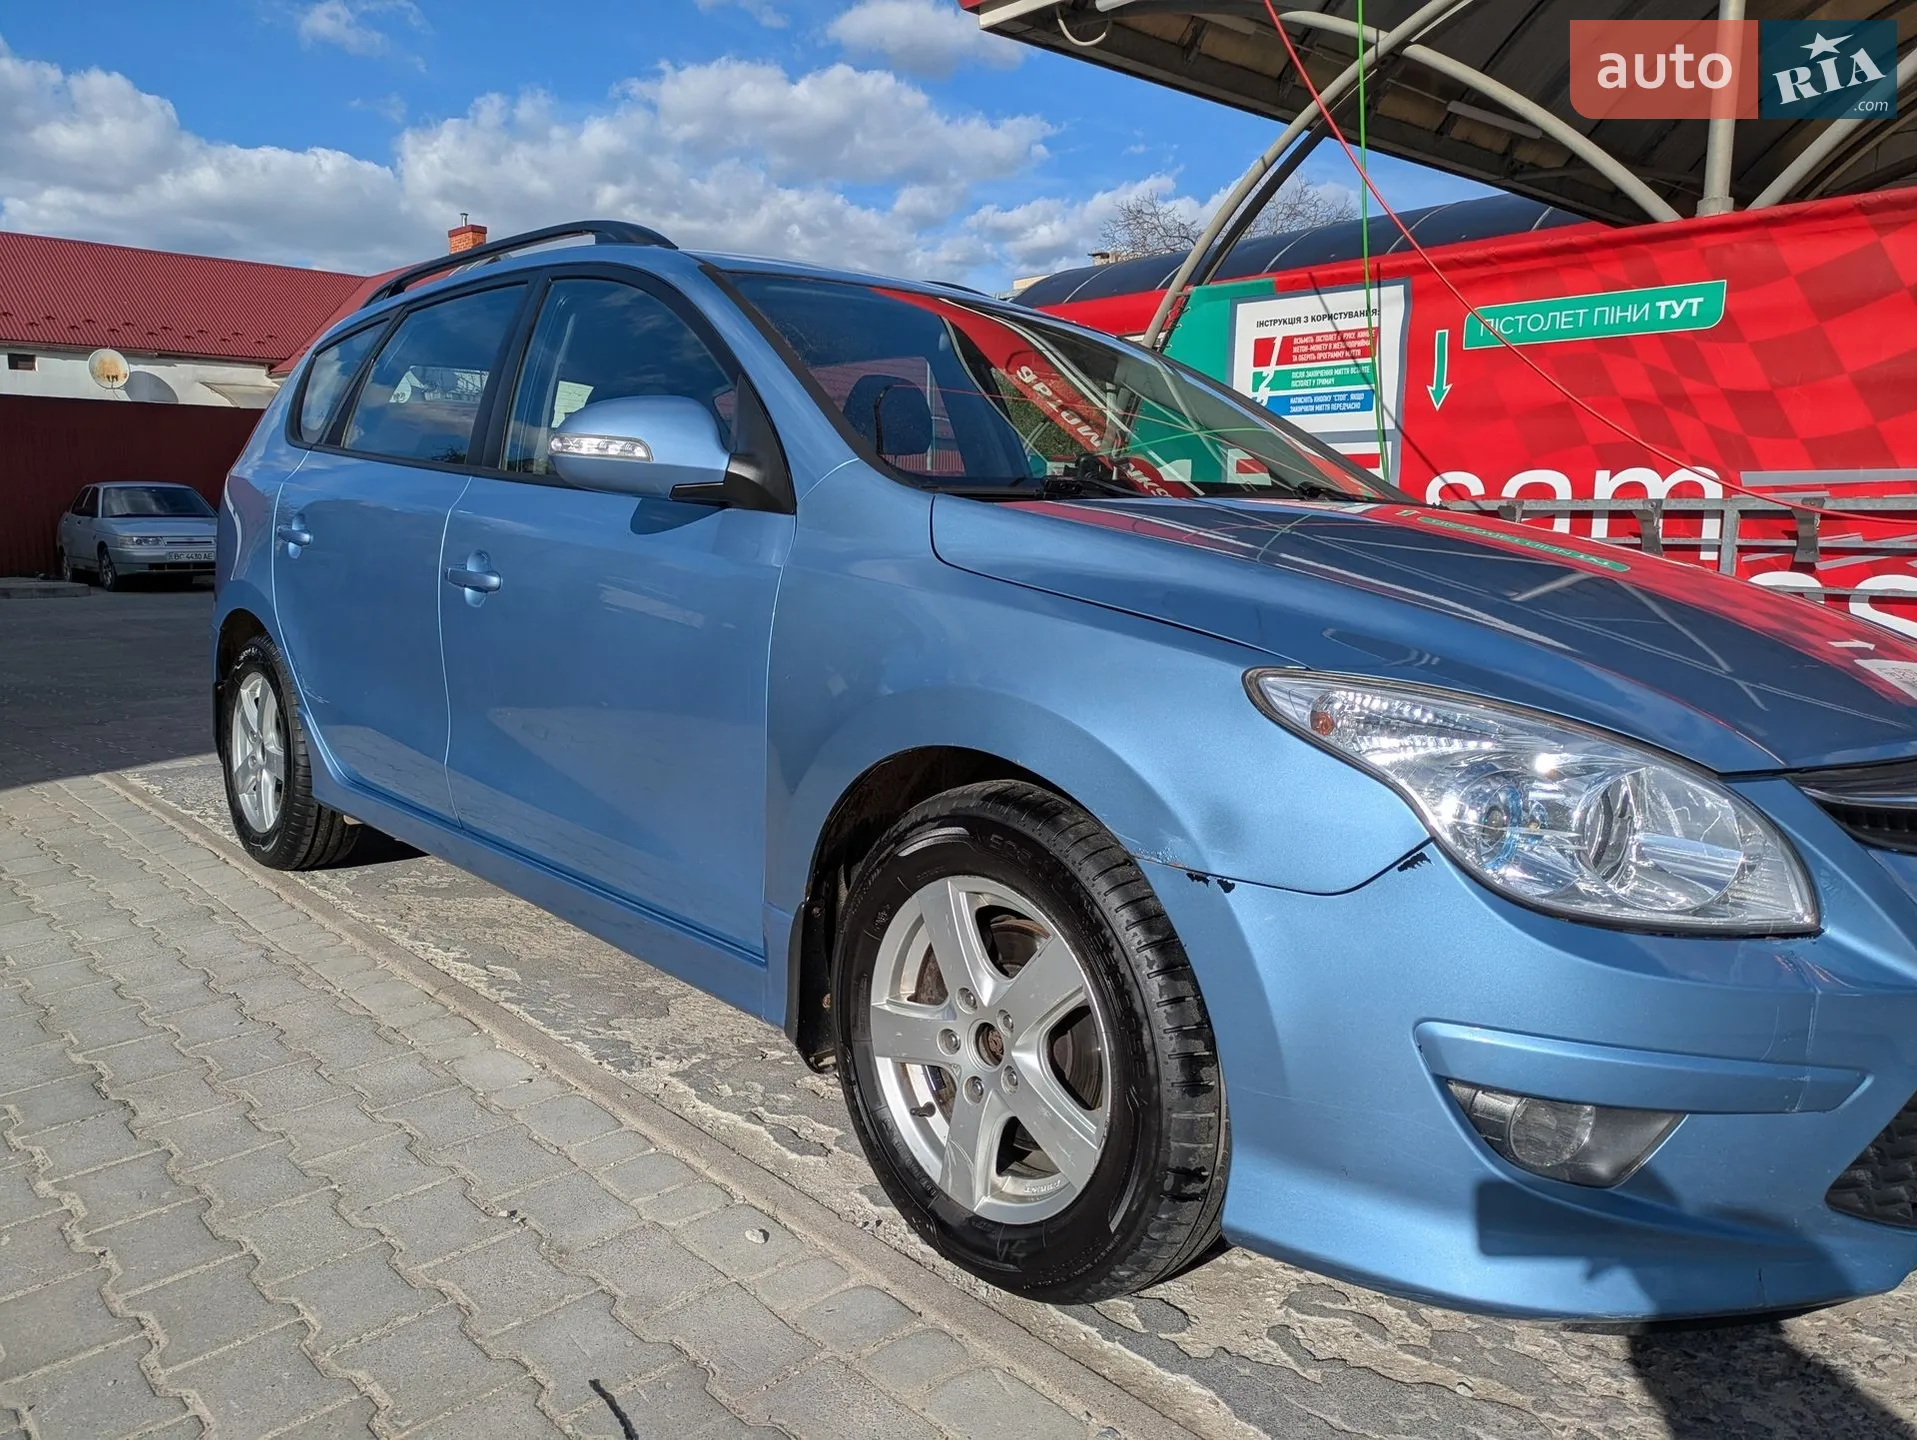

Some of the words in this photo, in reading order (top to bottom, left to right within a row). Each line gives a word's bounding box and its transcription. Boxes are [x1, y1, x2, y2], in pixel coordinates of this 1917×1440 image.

[1256, 316, 1302, 328] ІНСТРУКЦІЯ
[1310, 309, 1380, 323] КОРИСТУВАНЯ:
[1479, 308, 1589, 337] ПІСТОЛЕТ
[1593, 302, 1650, 326] ПІНИ
[1655, 297, 1704, 320] ТУТ
